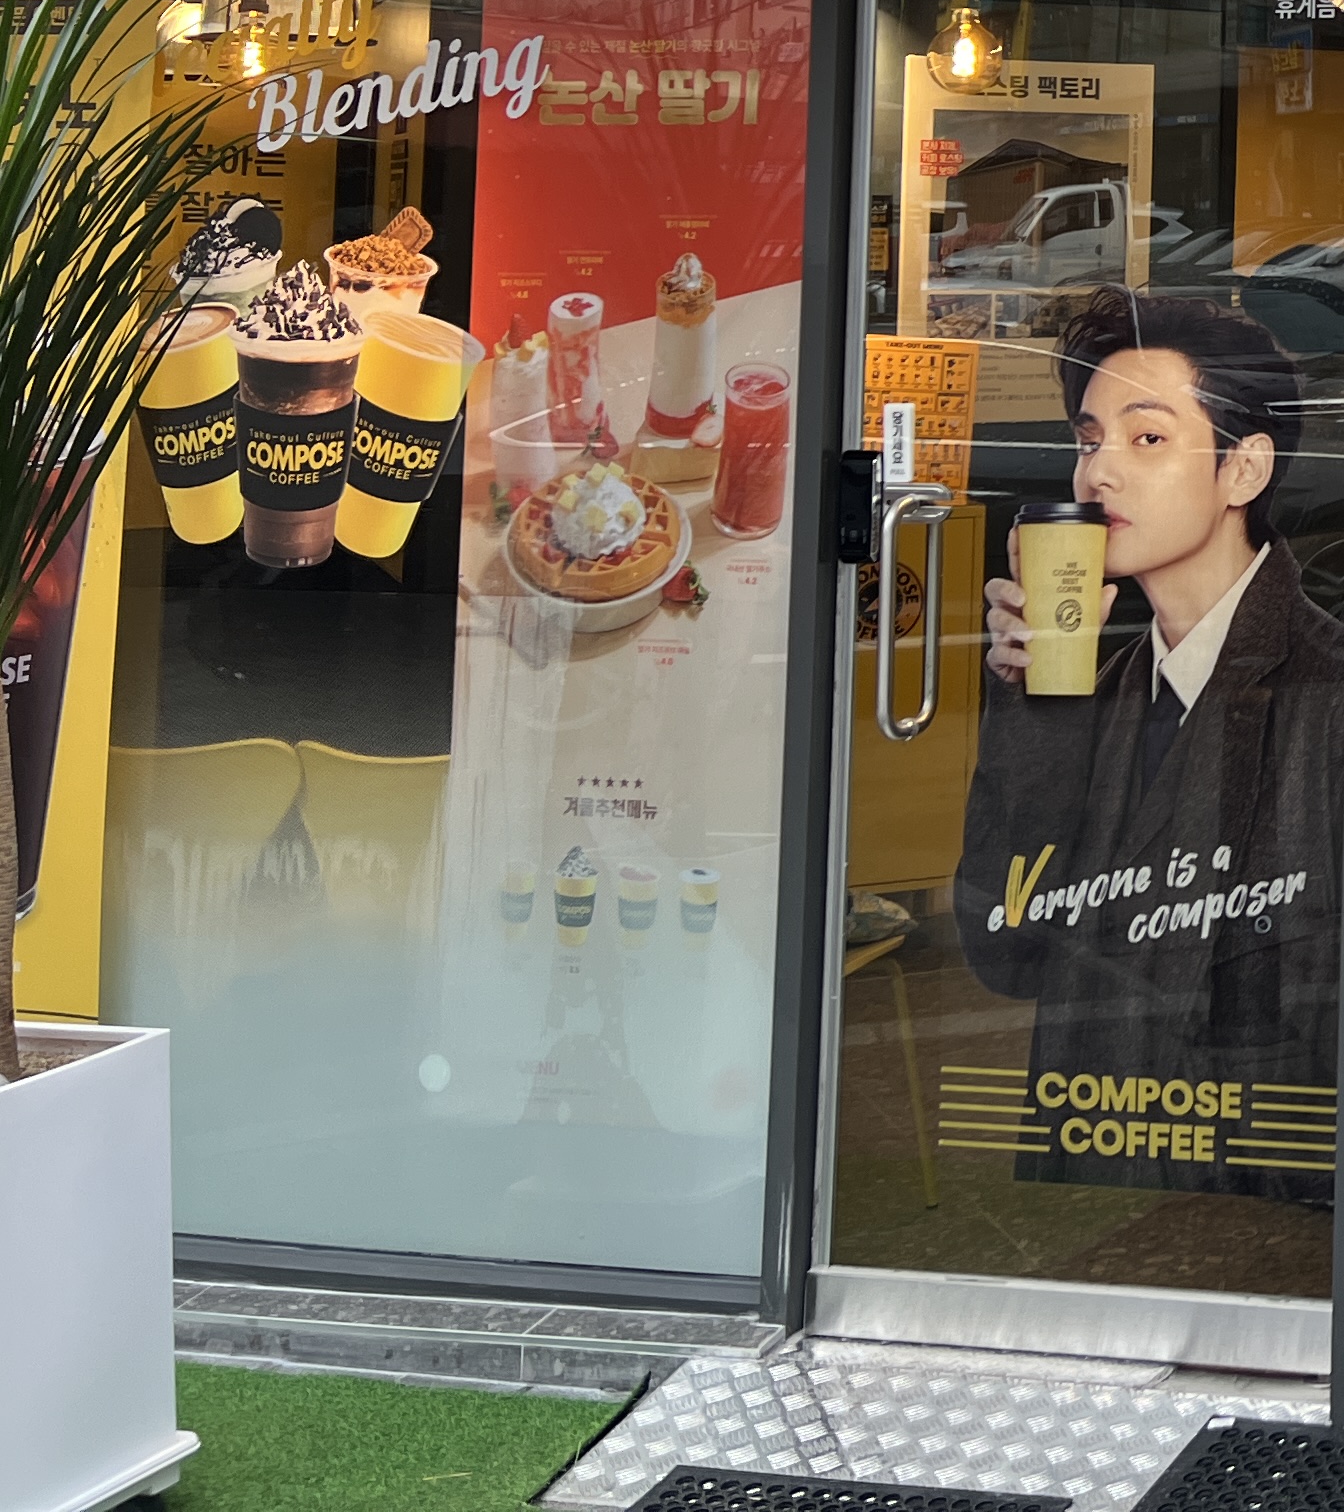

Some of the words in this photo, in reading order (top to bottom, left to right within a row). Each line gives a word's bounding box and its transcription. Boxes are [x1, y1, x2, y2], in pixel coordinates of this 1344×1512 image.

[248, 34, 550, 154] Blending
[537, 71, 645, 126] 논산
[657, 68, 761, 125] 딸기
[1037, 76, 1101, 101] 팩토리
[154, 416, 236, 457] COMPOS
[178, 445, 226, 467] COFFEE
[246, 439, 345, 473] COMPOSE
[891, 411, 905, 465] 당기세요
[268, 471, 320, 486] COFFEE
[363, 458, 413, 482] COFFEE
[563, 796, 659, 820] 겨울추천메뉴
[1166, 847, 1199, 888] is
[1212, 844, 1233, 872] a
[1127, 870, 1308, 944] composer
[1036, 1071, 1243, 1120] COMPOSE
[1060, 1117, 1216, 1163] COFFEE
